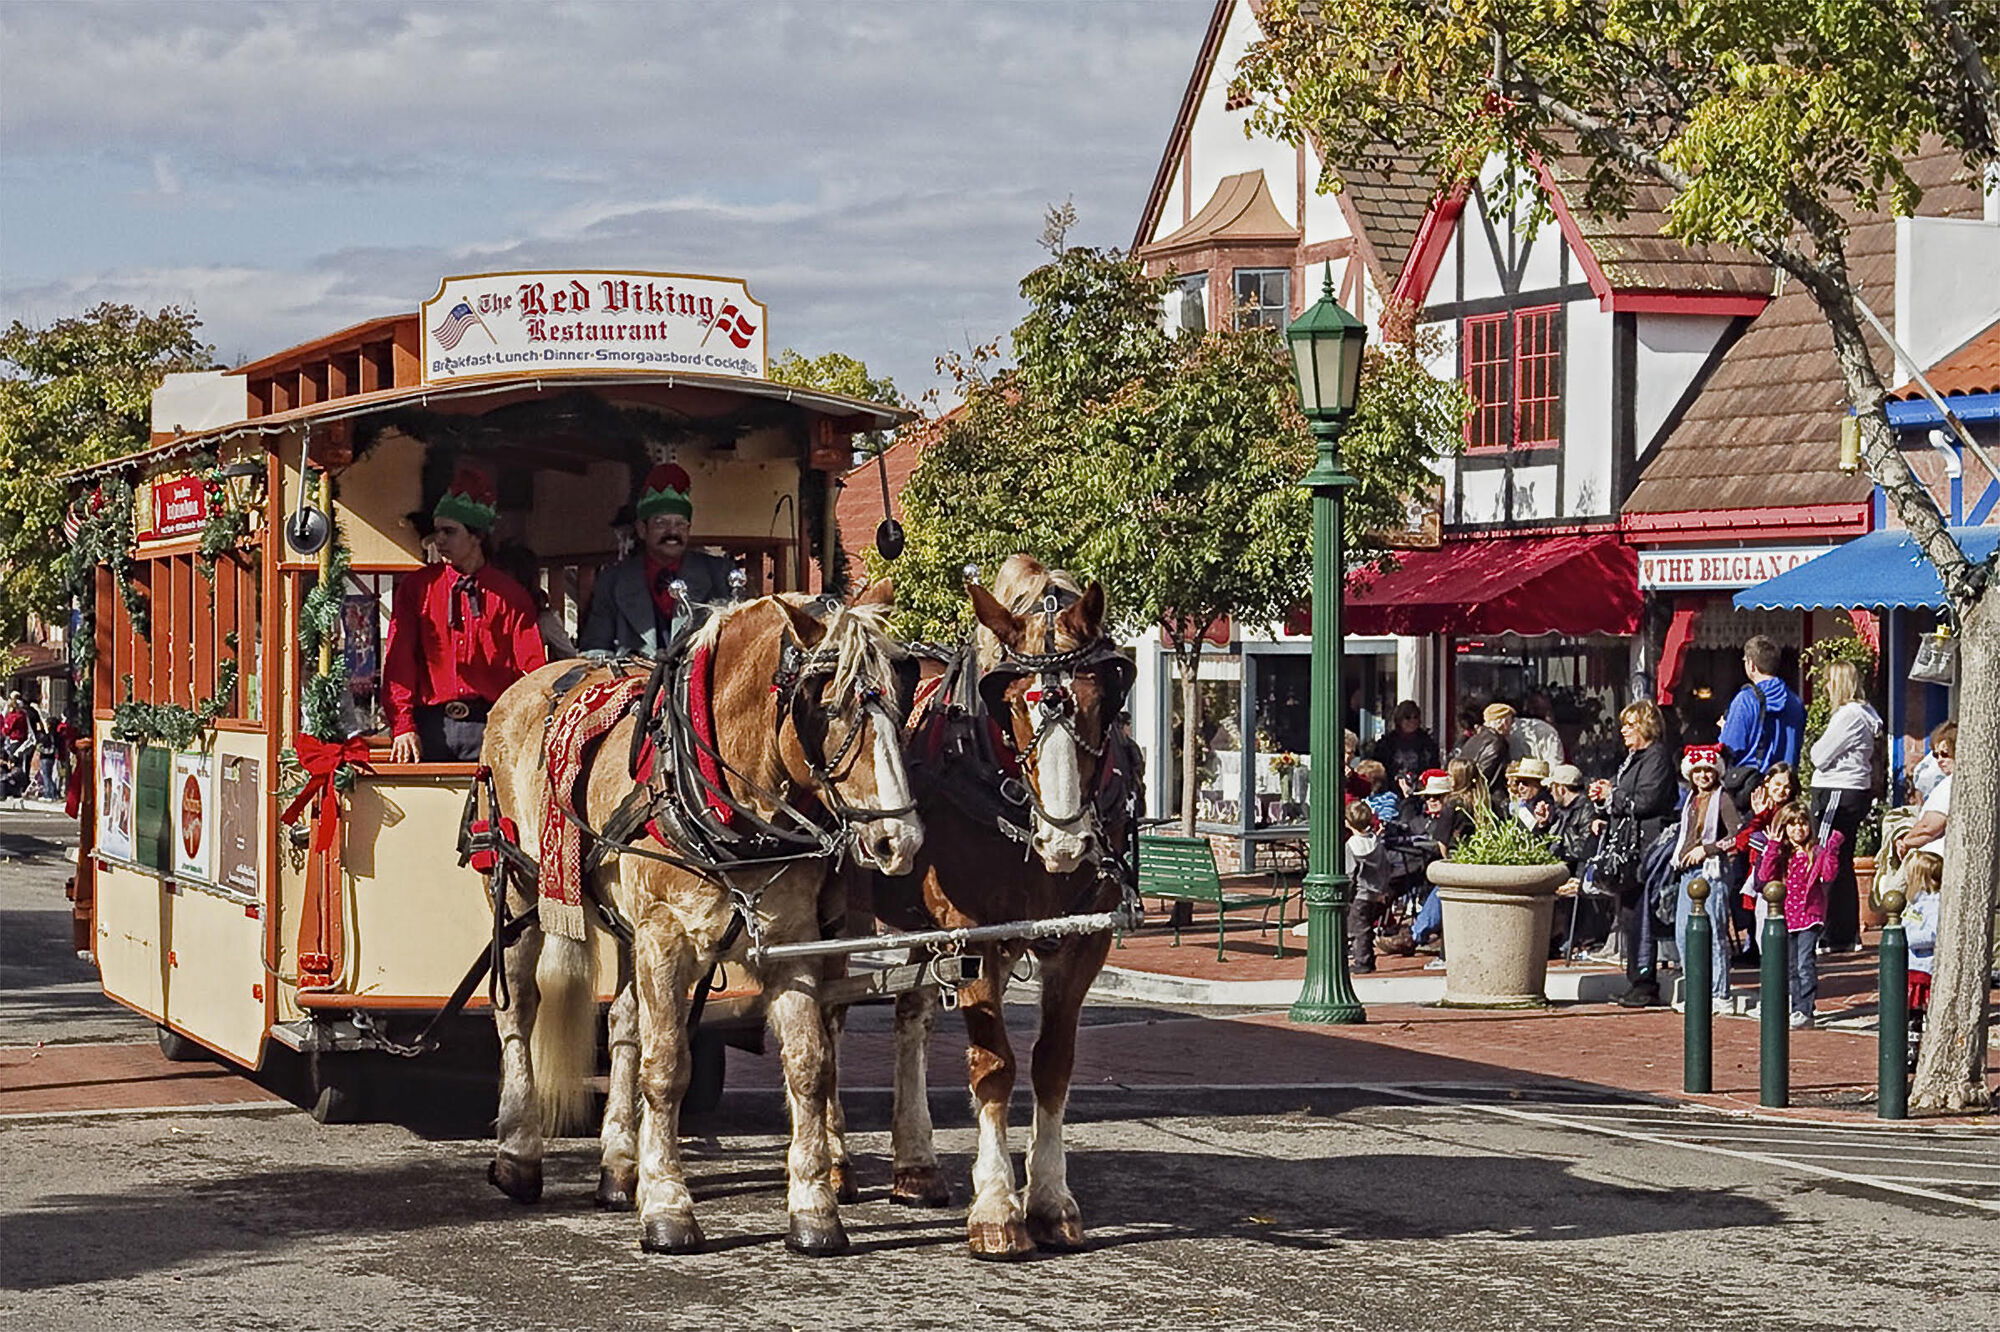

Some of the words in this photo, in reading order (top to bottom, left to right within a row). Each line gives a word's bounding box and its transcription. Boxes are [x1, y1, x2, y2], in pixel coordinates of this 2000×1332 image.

[478, 292, 512, 317] The
[517, 279, 590, 321] Red
[598, 279, 715, 328] Viking
[526, 318, 668, 344] Restaurant
[496, 350, 539, 364] Lunch
[544, 349, 590, 361] Dinner
[595, 348, 701, 365] Smorgaasbord
[1657, 558, 1694, 583] THE
[1699, 555, 1783, 581] BELGIAN
